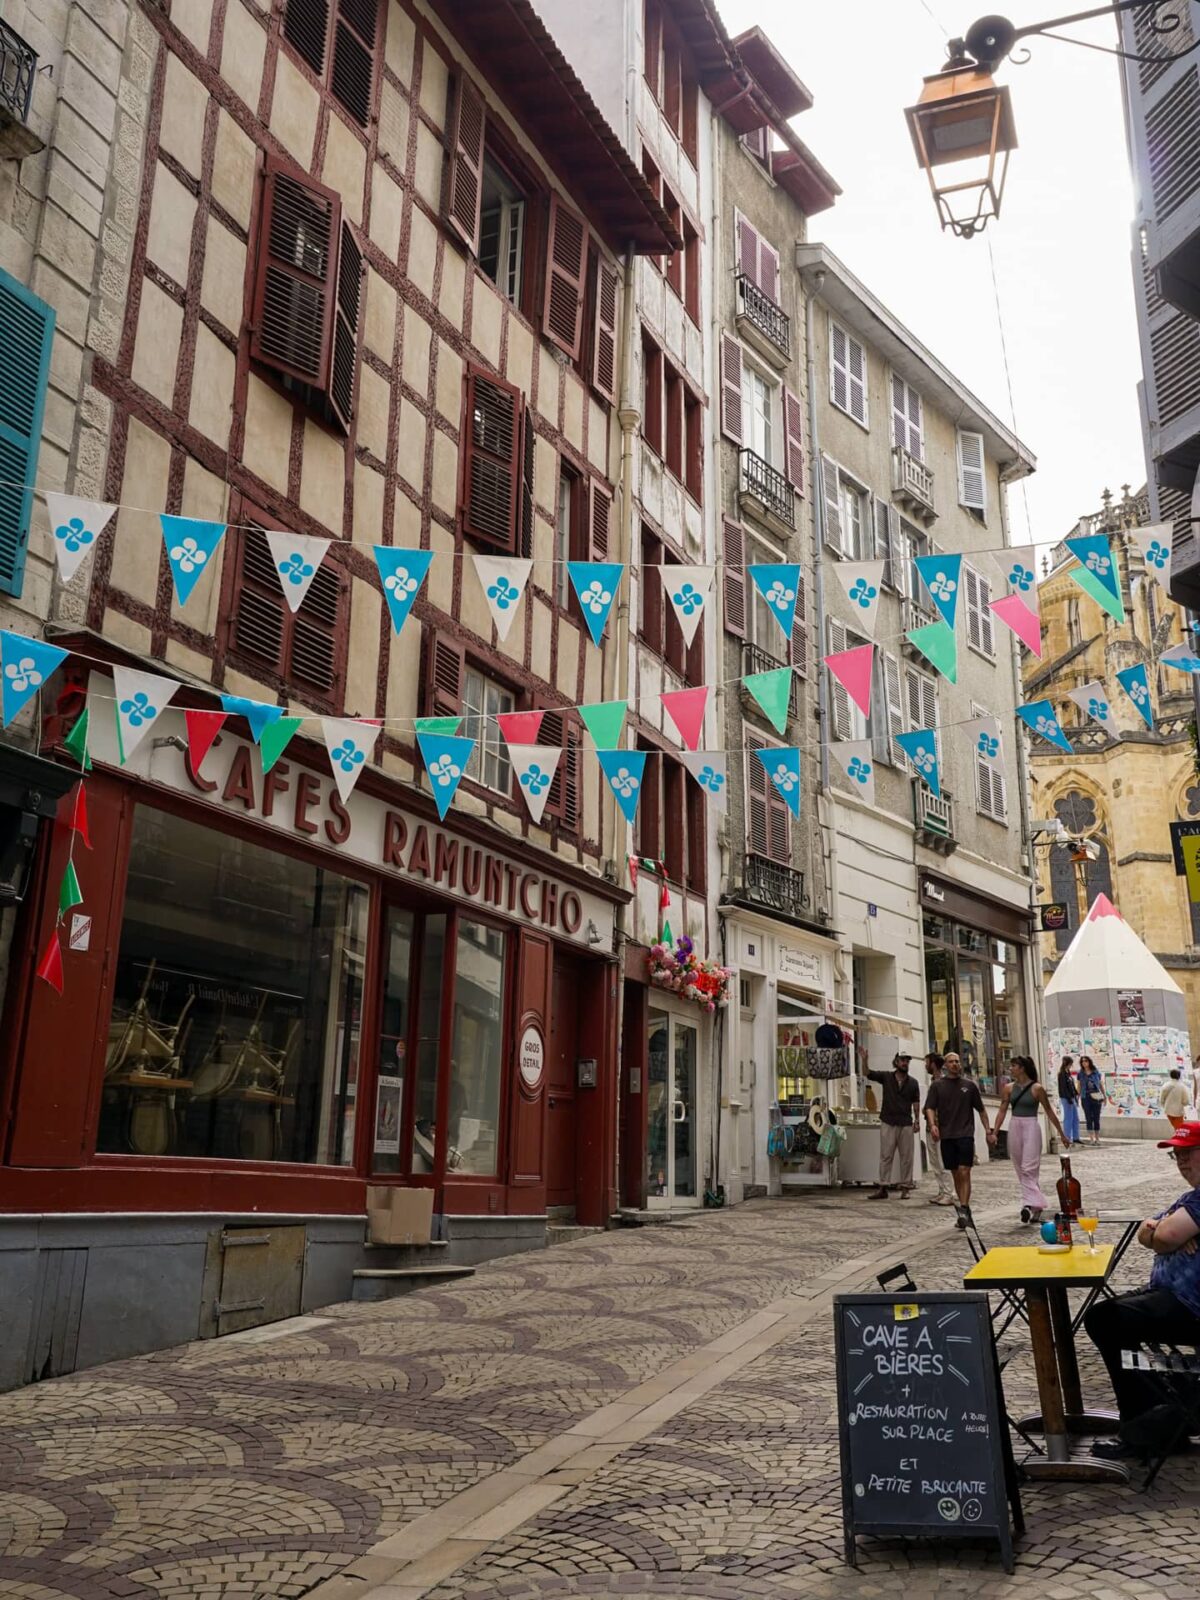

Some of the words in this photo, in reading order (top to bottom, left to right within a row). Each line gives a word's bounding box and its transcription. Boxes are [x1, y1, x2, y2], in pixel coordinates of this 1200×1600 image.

[184, 733, 352, 844] CAFES
[382, 810, 584, 934] RAMUNTCHO
[524, 1041, 540, 1053] GROS
[523, 1057, 540, 1069] DETAIL
[863, 1325, 909, 1348] CAVE
[915, 1326, 934, 1350] A
[874, 1349, 944, 1376] BIÈRES
[856, 1402, 949, 1421] RESTAURATION
[881, 1425, 908, 1440] SUR
[910, 1425, 955, 1442] PLACE
[899, 1458, 919, 1470] ET
[868, 1474, 912, 1494] PETITE
[921, 1479, 988, 1499] BROCANTE
